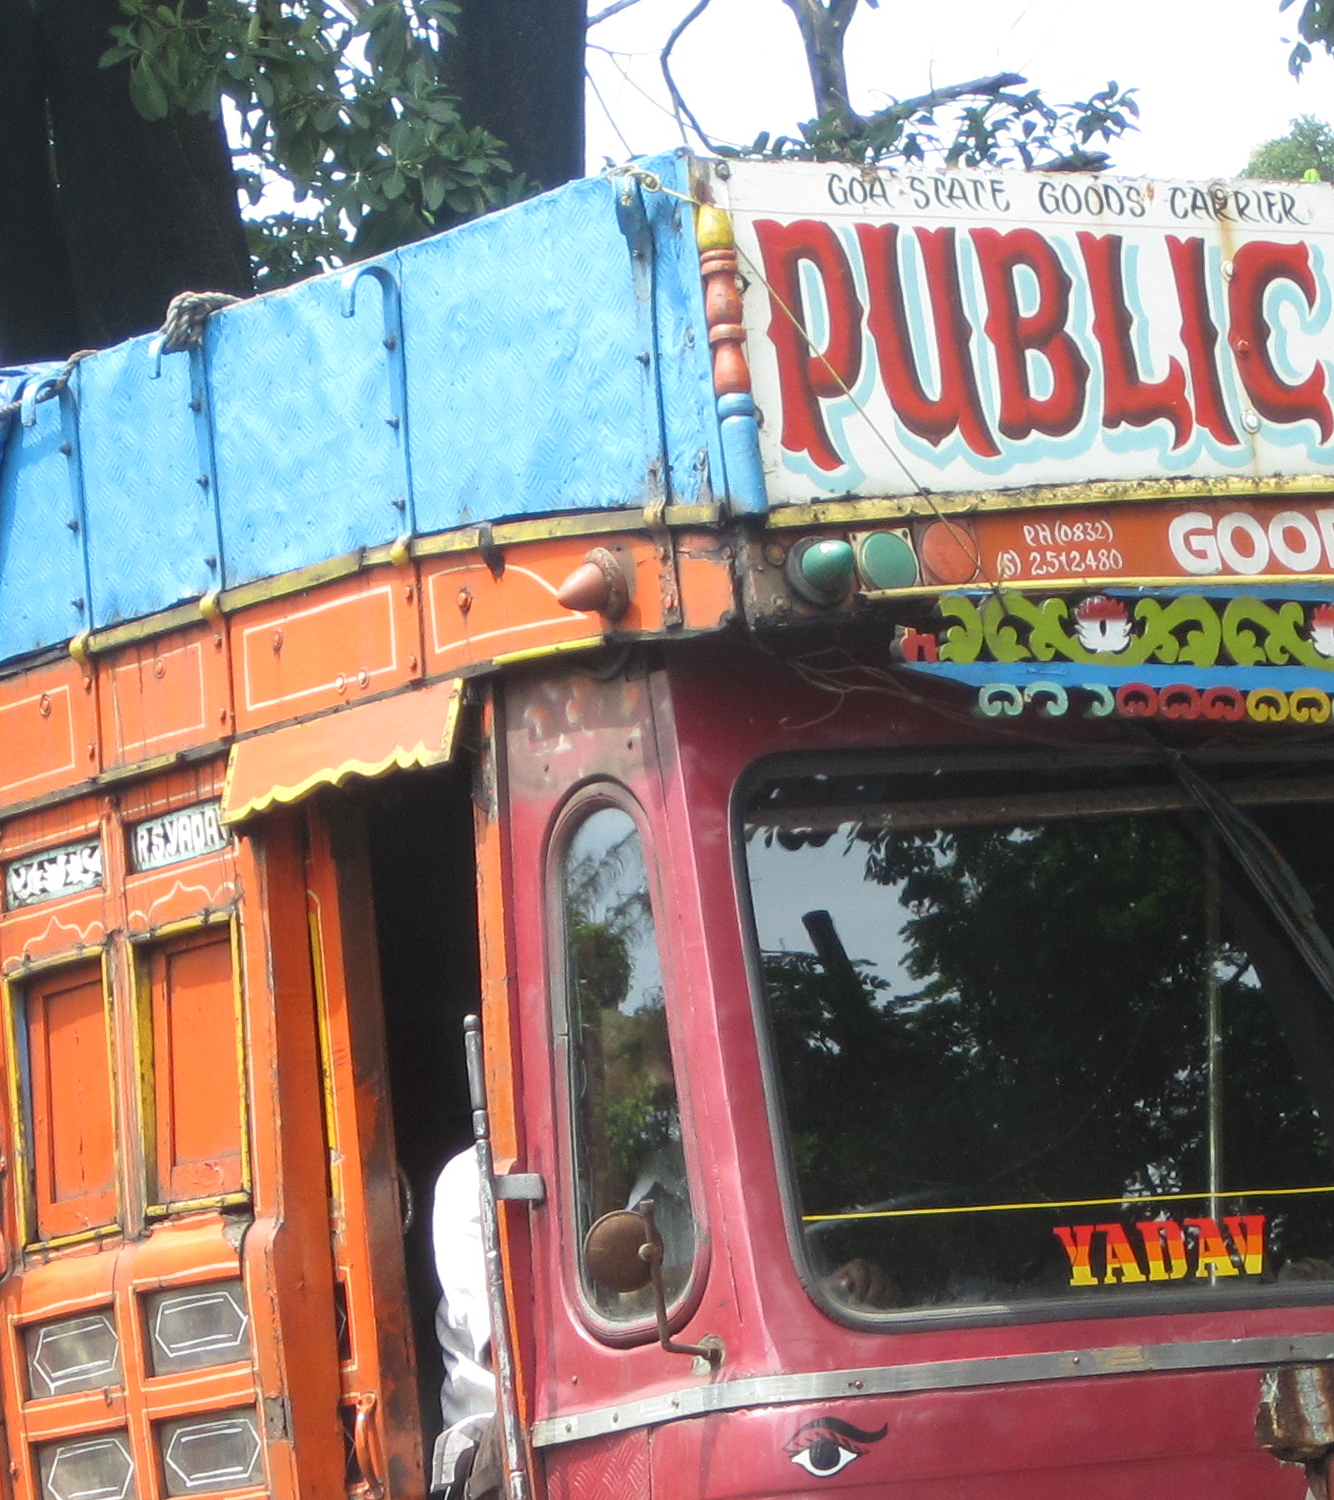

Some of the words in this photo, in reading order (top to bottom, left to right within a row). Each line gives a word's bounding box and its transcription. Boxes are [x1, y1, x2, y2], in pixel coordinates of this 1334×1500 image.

[827, 172, 898, 211] GOA
[909, 176, 1011, 211] STATE
[1038, 181, 1146, 218] GOODS
[1169, 184, 1311, 225] CARRIER
[1030, 548, 1123, 577] 2512480
[1053, 1215, 1265, 1286] YADAV
